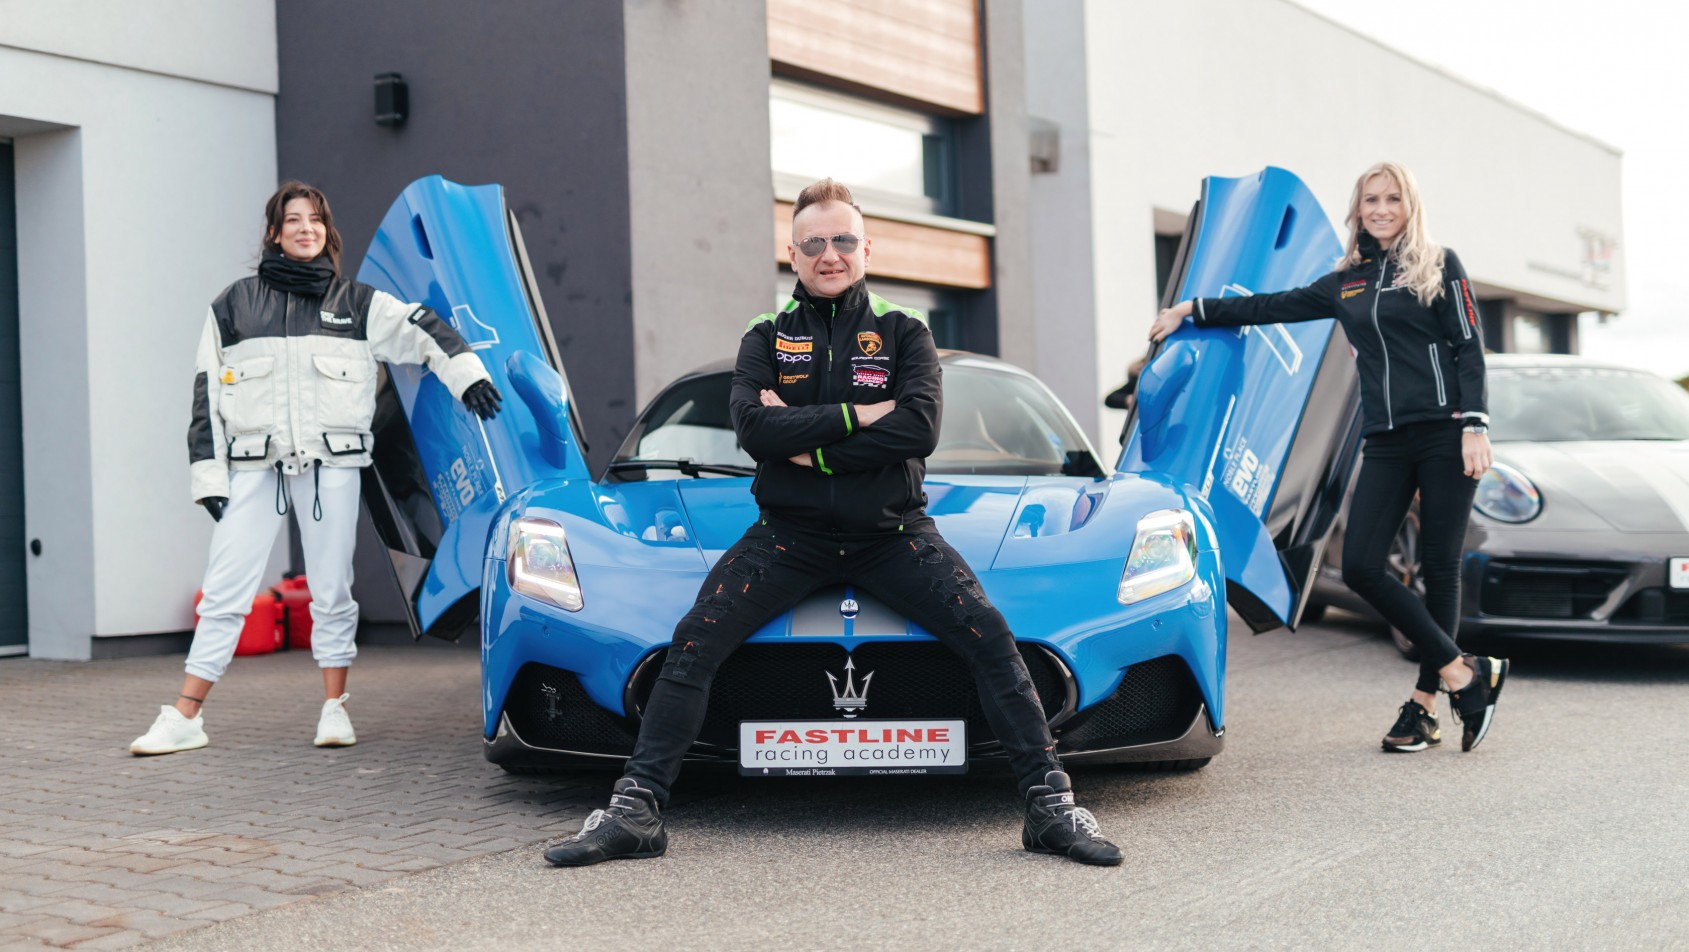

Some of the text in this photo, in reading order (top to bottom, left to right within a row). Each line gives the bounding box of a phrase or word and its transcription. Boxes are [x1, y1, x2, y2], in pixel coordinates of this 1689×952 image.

[776, 352, 812, 363] oppo
[450, 457, 475, 506] evo
[1232, 448, 1259, 498] evo
[755, 728, 950, 744] FASTLINE
[755, 745, 950, 764] racing academy
[786, 768, 836, 776] Maserati Pietrzak
